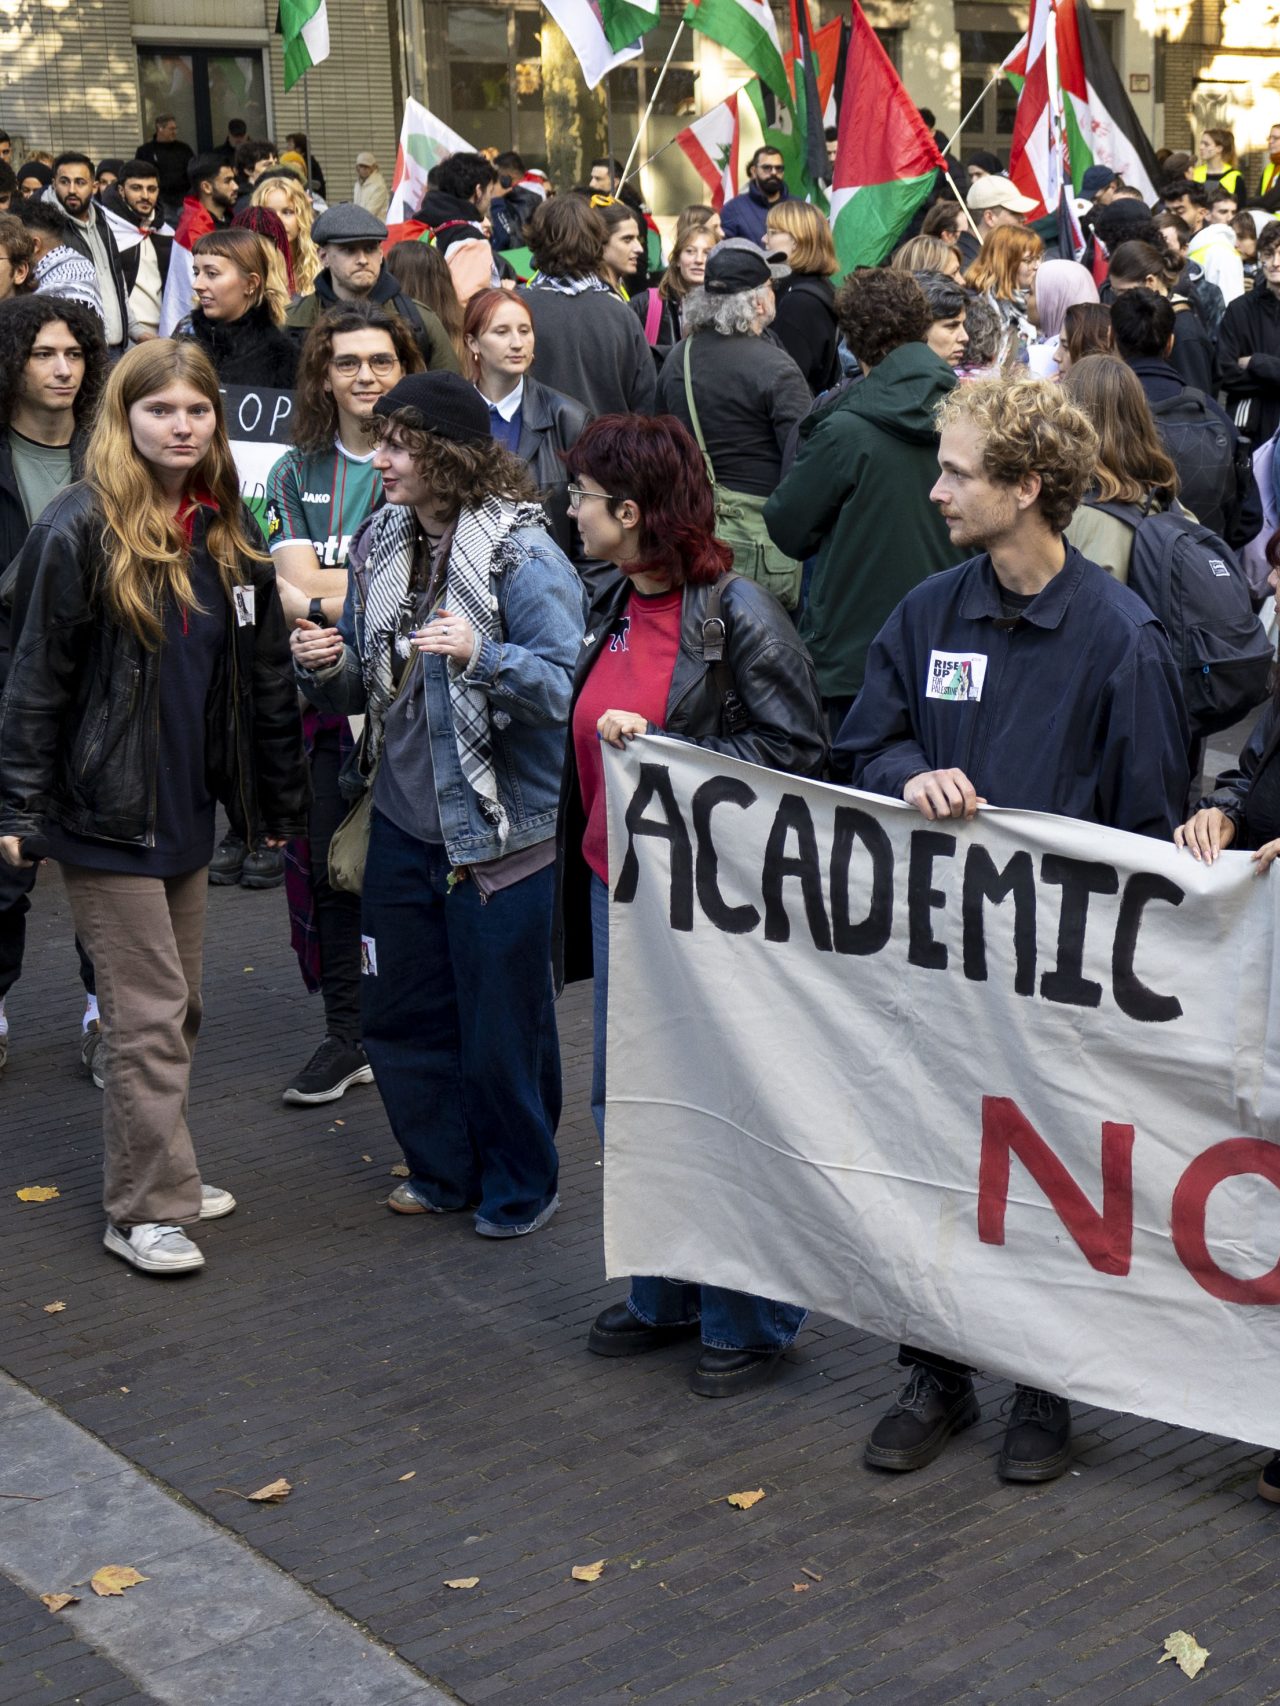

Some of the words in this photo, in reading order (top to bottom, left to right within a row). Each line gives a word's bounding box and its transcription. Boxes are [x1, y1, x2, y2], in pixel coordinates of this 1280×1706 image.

[219, 389, 292, 436] OP
[301, 491, 331, 504] JAKO
[934, 659, 960, 671] RISE
[933, 668, 950, 678] UP
[932, 677, 943, 686] FOR
[931, 685, 958, 696] PALESTINE
[613, 763, 1186, 1022] ACADEMIC
